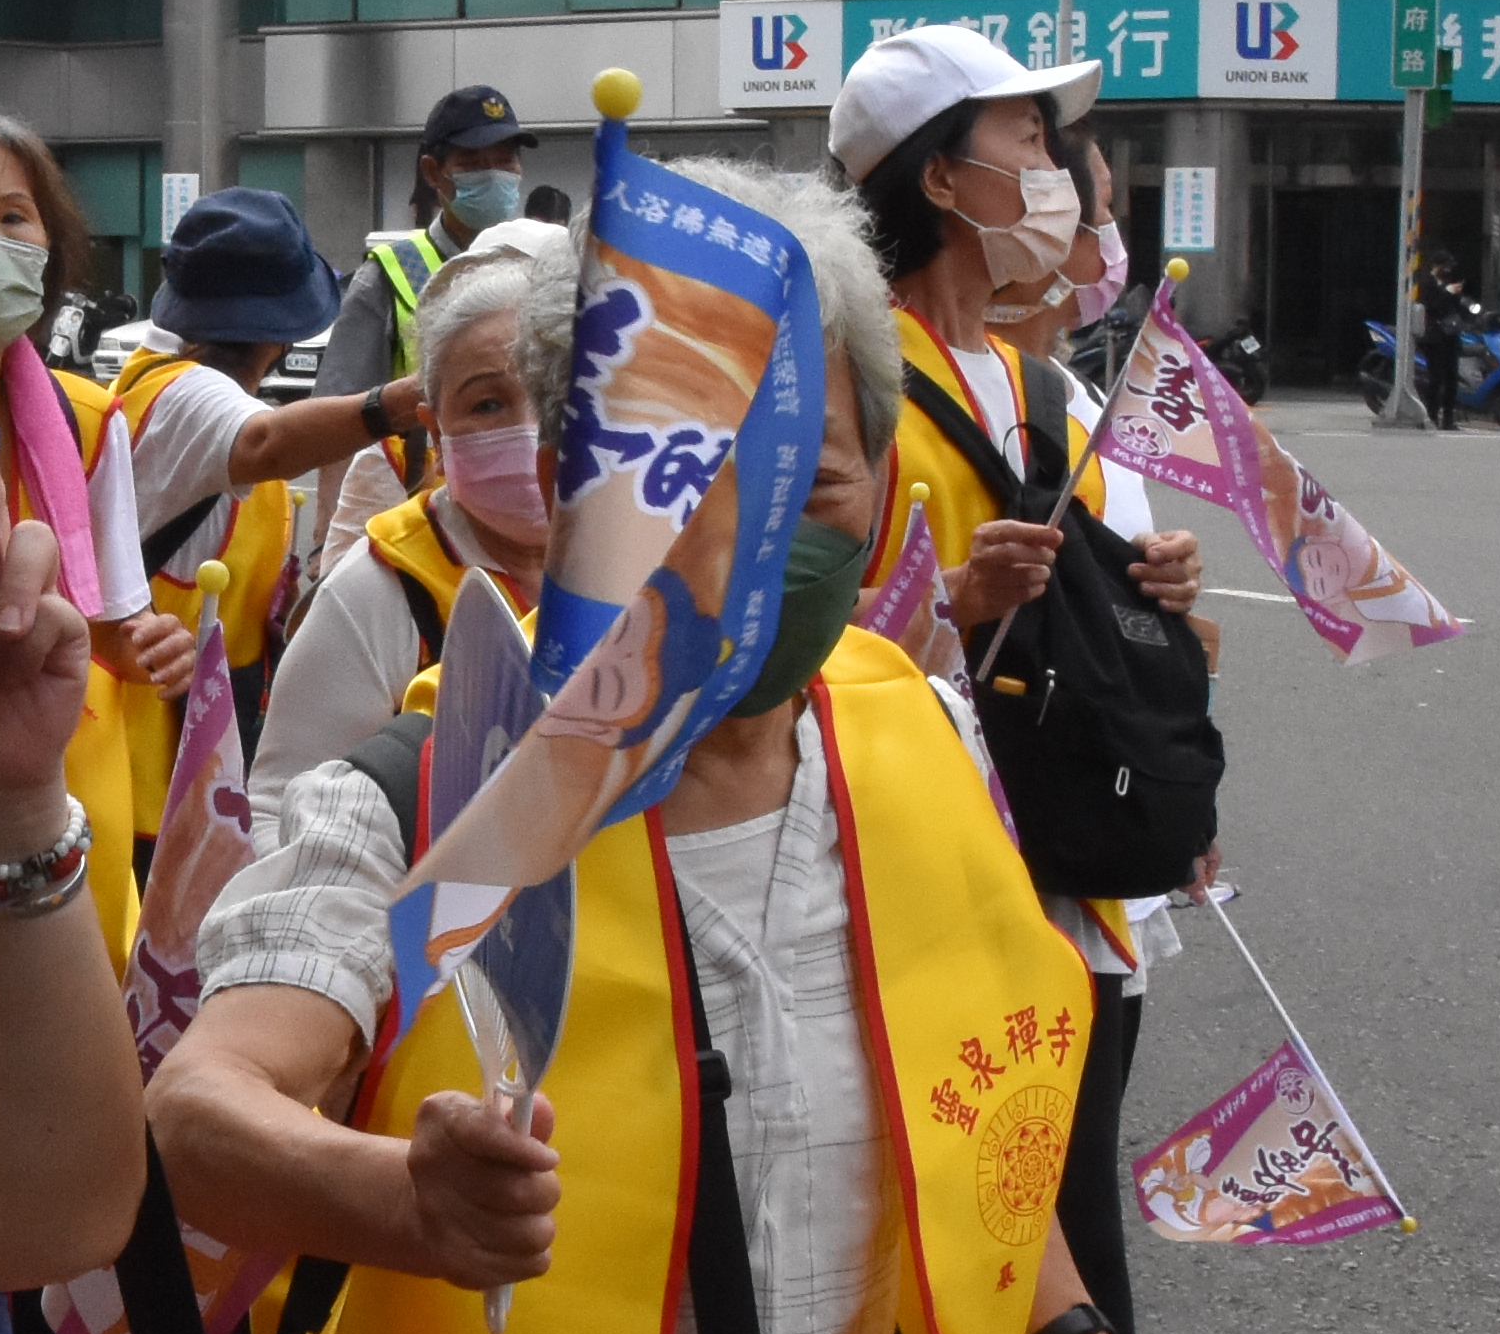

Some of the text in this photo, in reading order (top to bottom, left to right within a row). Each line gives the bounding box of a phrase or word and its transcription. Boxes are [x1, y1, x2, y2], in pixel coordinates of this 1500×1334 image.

[1225, 70, 1309, 84] UNION BANK
[742, 79, 817, 93] UNION BANK
[930, 1005, 1078, 1137] 靈泉禪寺
